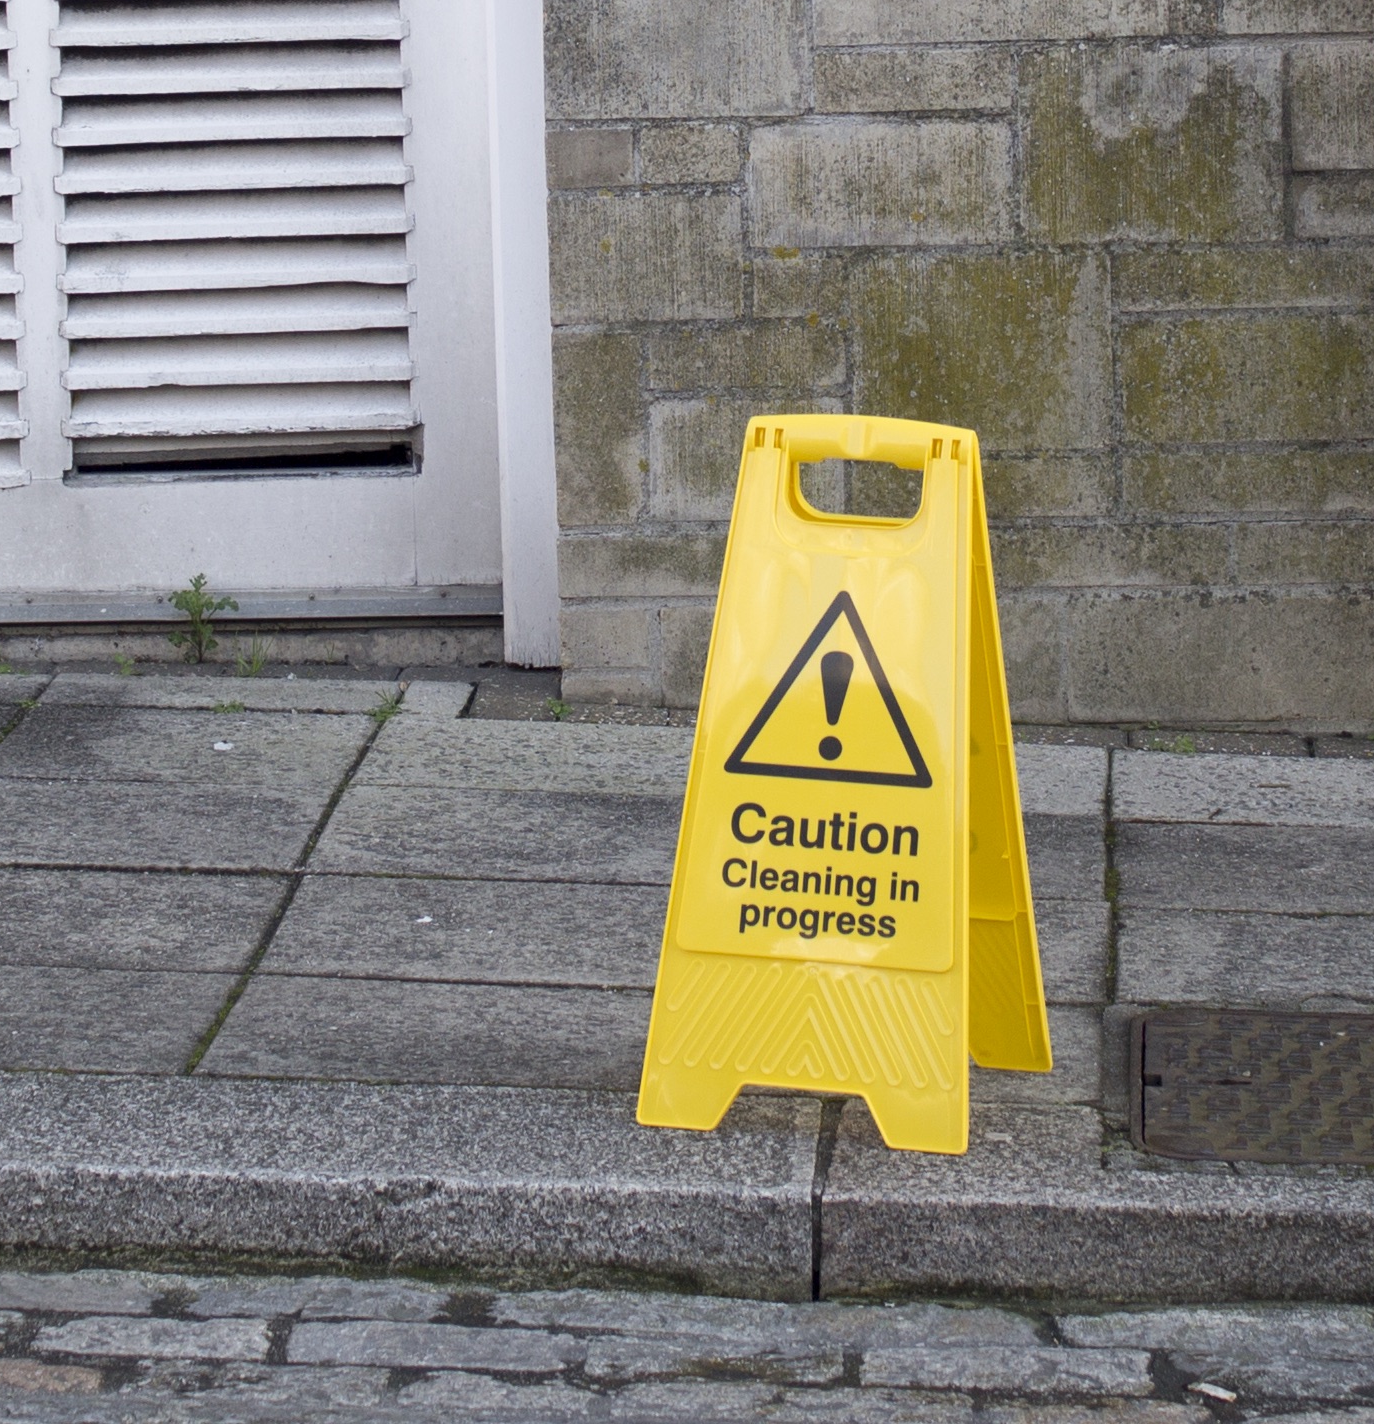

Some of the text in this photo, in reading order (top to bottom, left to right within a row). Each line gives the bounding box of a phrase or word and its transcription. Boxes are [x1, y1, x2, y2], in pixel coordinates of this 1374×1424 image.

[730, 802, 920, 857] Caution
[721, 857, 920, 907] Cleaning in
[738, 903, 897, 939] progress
